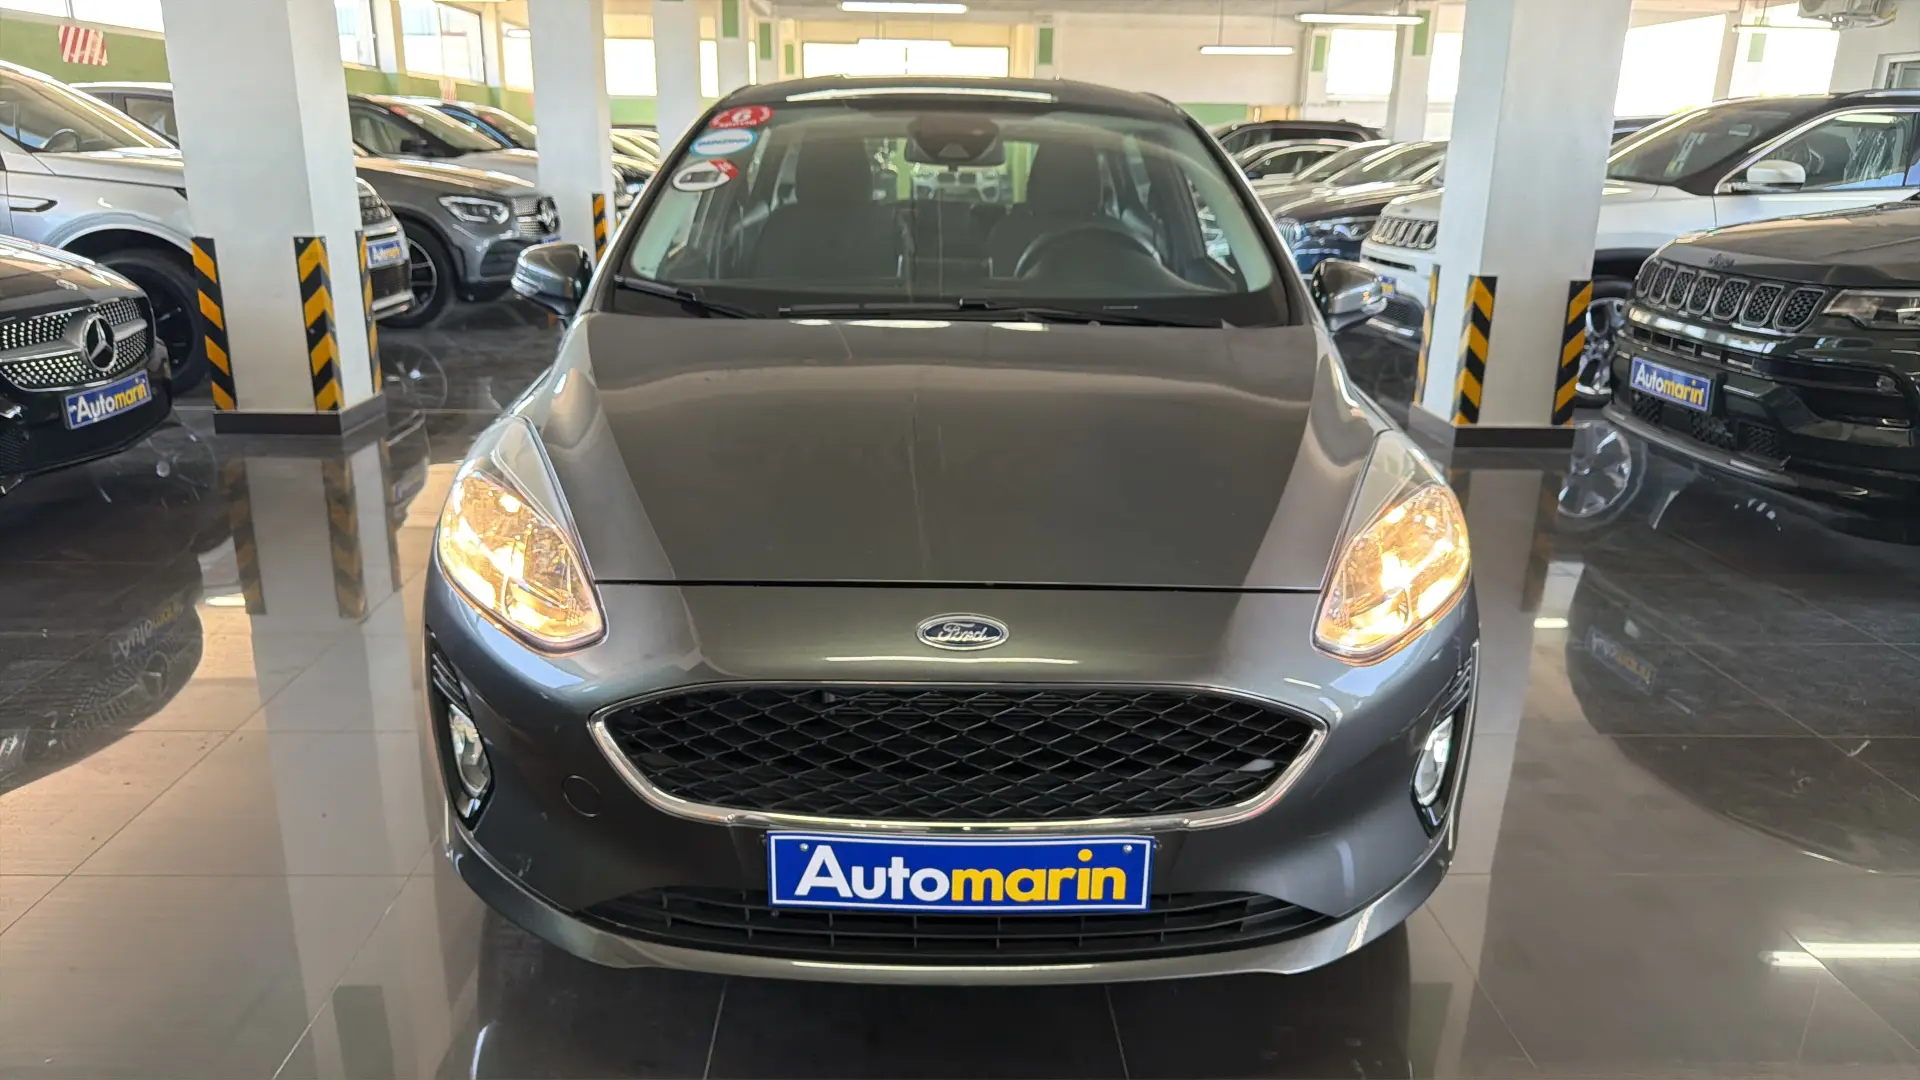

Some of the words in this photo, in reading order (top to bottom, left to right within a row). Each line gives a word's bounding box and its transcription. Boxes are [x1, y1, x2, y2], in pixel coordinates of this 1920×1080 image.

[77, 377, 147, 422] Automarin
[1634, 363, 1704, 405] Automarin
[936, 622, 988, 641] Ford
[794, 845, 1126, 901] Automarin
